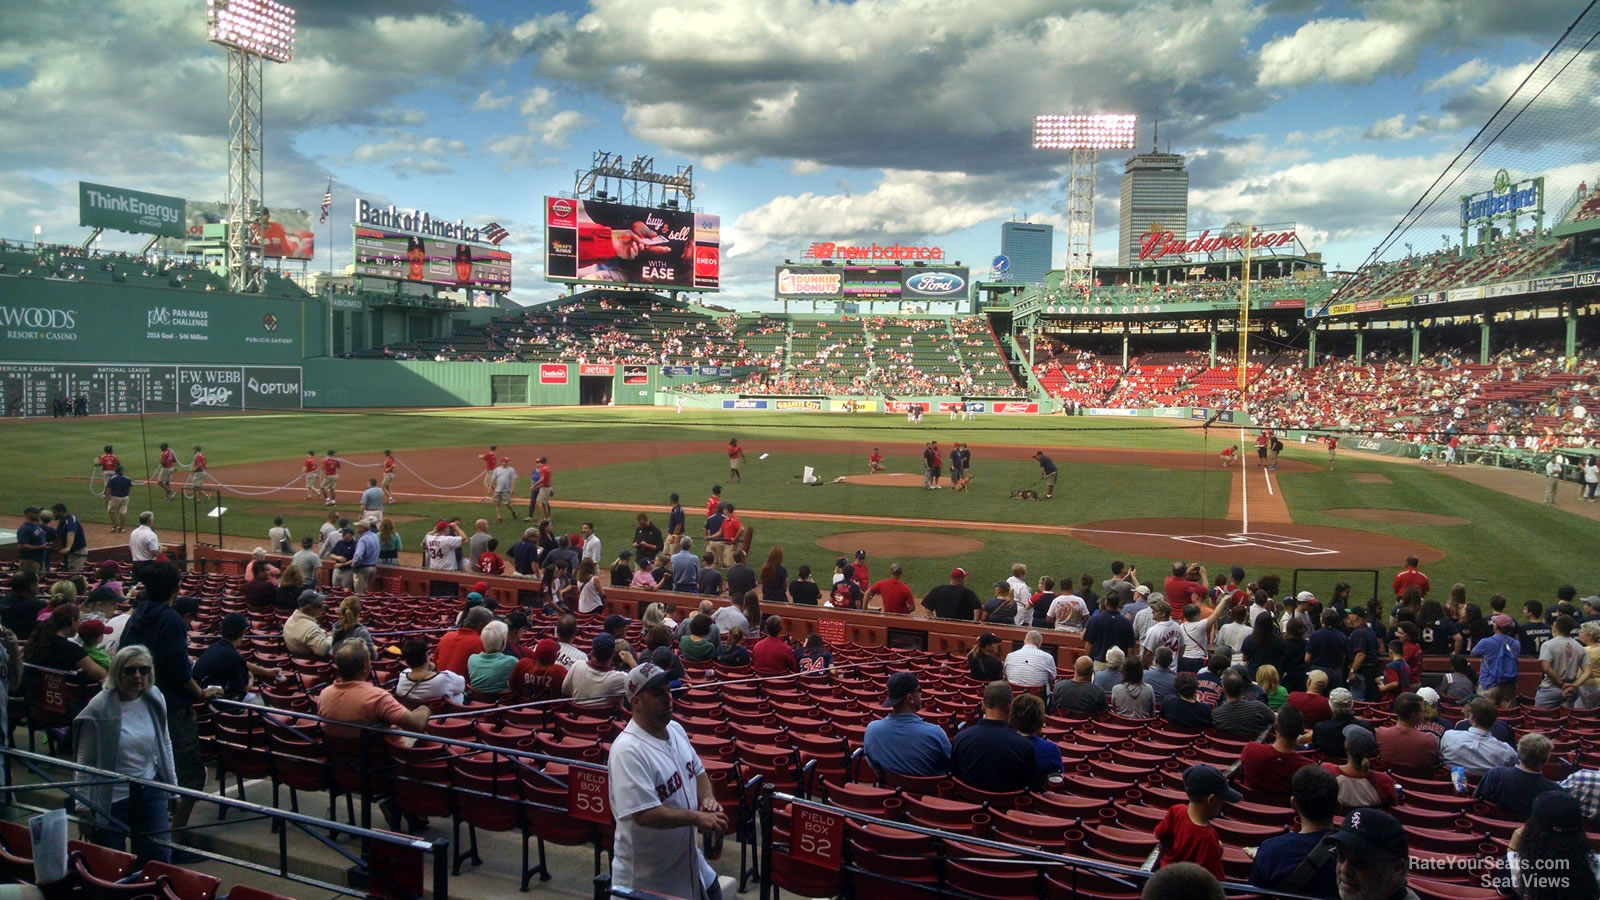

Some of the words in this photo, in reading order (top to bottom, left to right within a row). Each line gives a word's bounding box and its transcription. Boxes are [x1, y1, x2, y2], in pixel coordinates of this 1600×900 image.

[87, 190, 179, 223] ThinkEnergy
[1462, 185, 1536, 221] Cumberland
[356, 198, 406, 232] Bank
[409, 210, 425, 232] of
[421, 212, 486, 243] America
[646, 213, 664, 230] buy
[668, 226, 691, 241] sell
[1138, 227, 1295, 260] Budweiser
[837, 246, 870, 259] new
[872, 243, 942, 259] balance
[648, 260, 667, 268] WITH
[696, 257, 718, 265] ENEOS
[642, 266, 675, 280] EASE
[796, 275, 839, 284] DUNKIN'
[1579, 274, 1596, 285] ALEX
[796, 283, 838, 292] DONUTS
[917, 275, 953, 292] Ford
[172, 309, 208, 319] PAN-MASS
[172, 318, 208, 327] CHALLENGE
[7, 331, 39, 339] RESORT
[46, 332, 77, 340] CASINO
[190, 333, 208, 341] Million
[180, 370, 203, 383] F.W.
[205, 370, 241, 383] WEBB
[584, 366, 610, 374] aetna
[260, 383, 299, 394] OPTUM
[429, 548, 444, 559] 34
[481, 562, 492, 573] 34
[1422, 628, 1434, 643] 8
[799, 656, 825, 674] 34
[524, 672, 553, 687] ORTIZ
[46, 690, 63, 706] 55
[577, 771, 606, 785] FIELD
[580, 781, 602, 793] BOX
[655, 770, 683, 803] RED
[576, 793, 605, 814] 53
[801, 810, 835, 827] FIELD
[804, 820, 829, 836] BOX
[799, 834, 832, 858] 52
